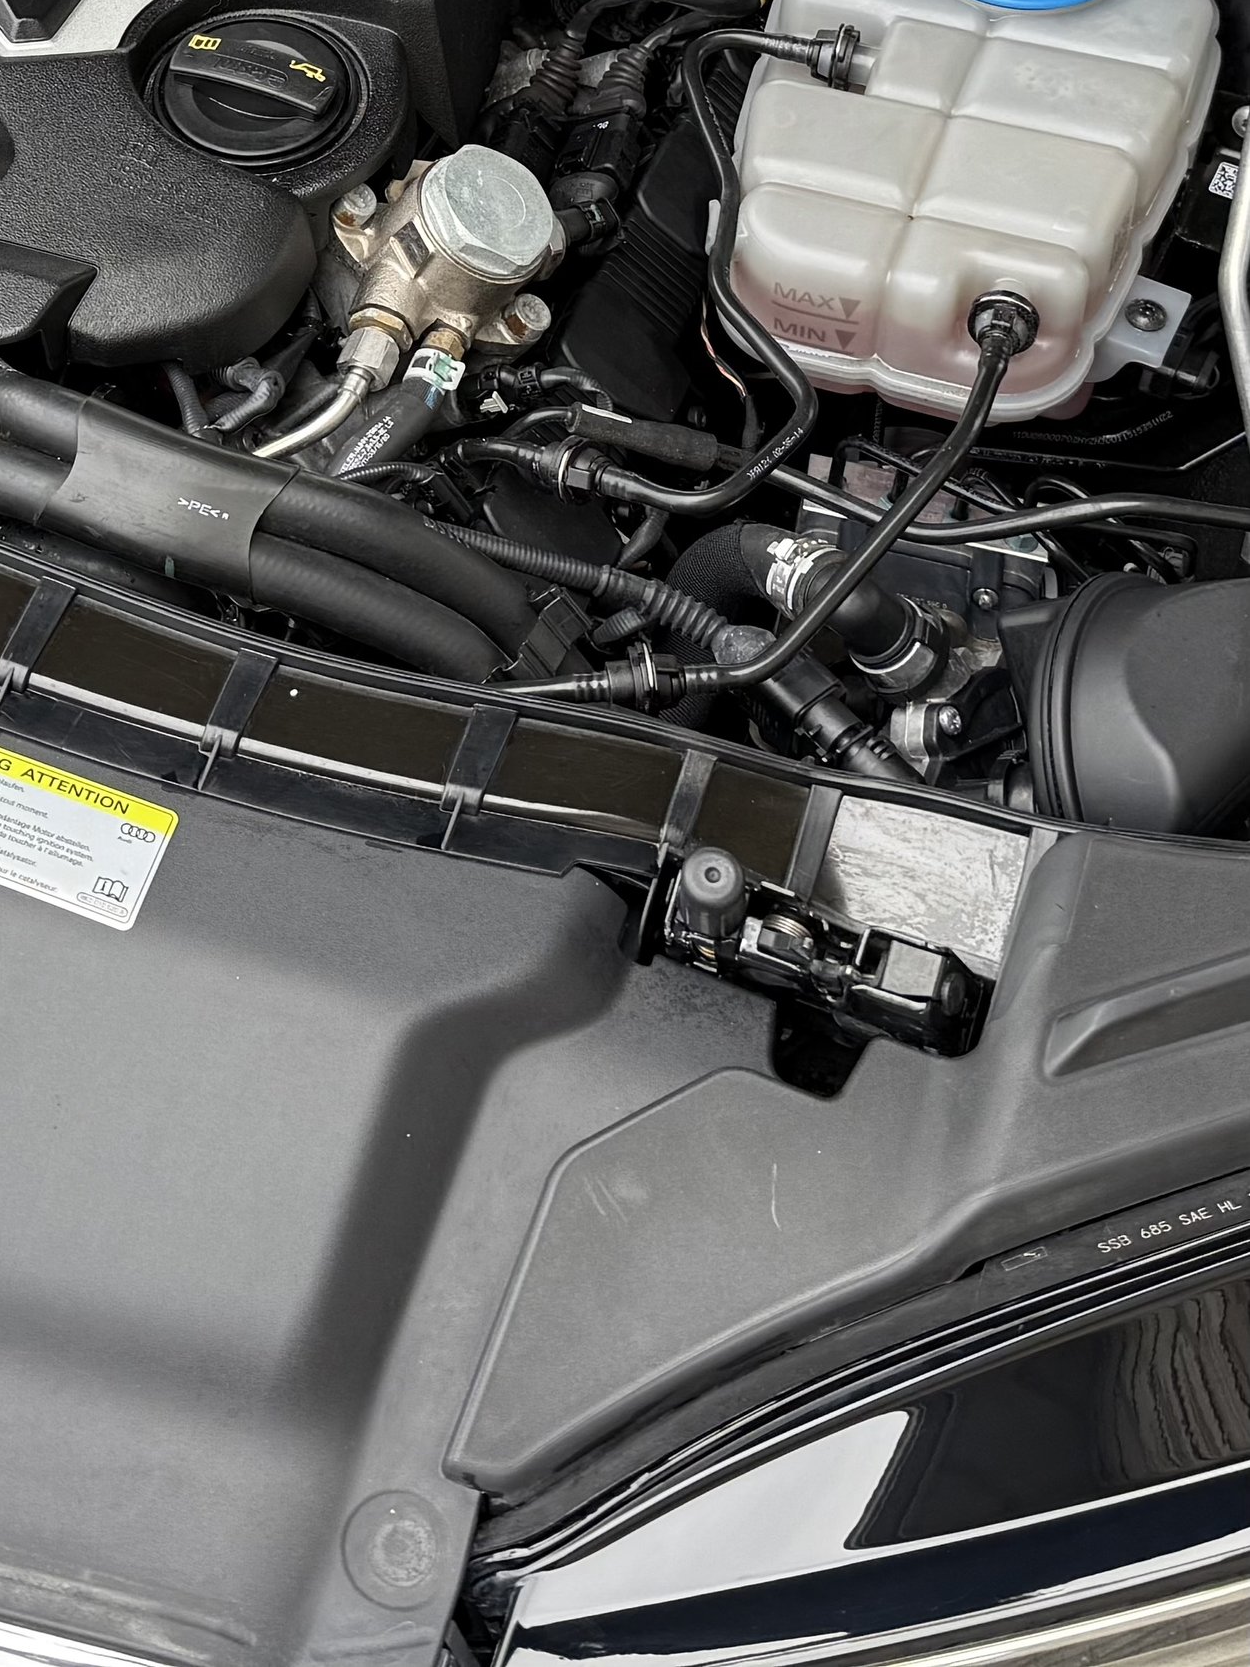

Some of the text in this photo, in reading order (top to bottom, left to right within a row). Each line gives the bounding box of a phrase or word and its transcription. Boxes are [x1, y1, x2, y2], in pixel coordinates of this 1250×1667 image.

[774, 282, 835, 311] MAX
[774, 316, 826, 343] MIN
[20, 766, 130, 814] ATTENTION
[1097, 1200, 1242, 1253] SSB 685 SAE HL
